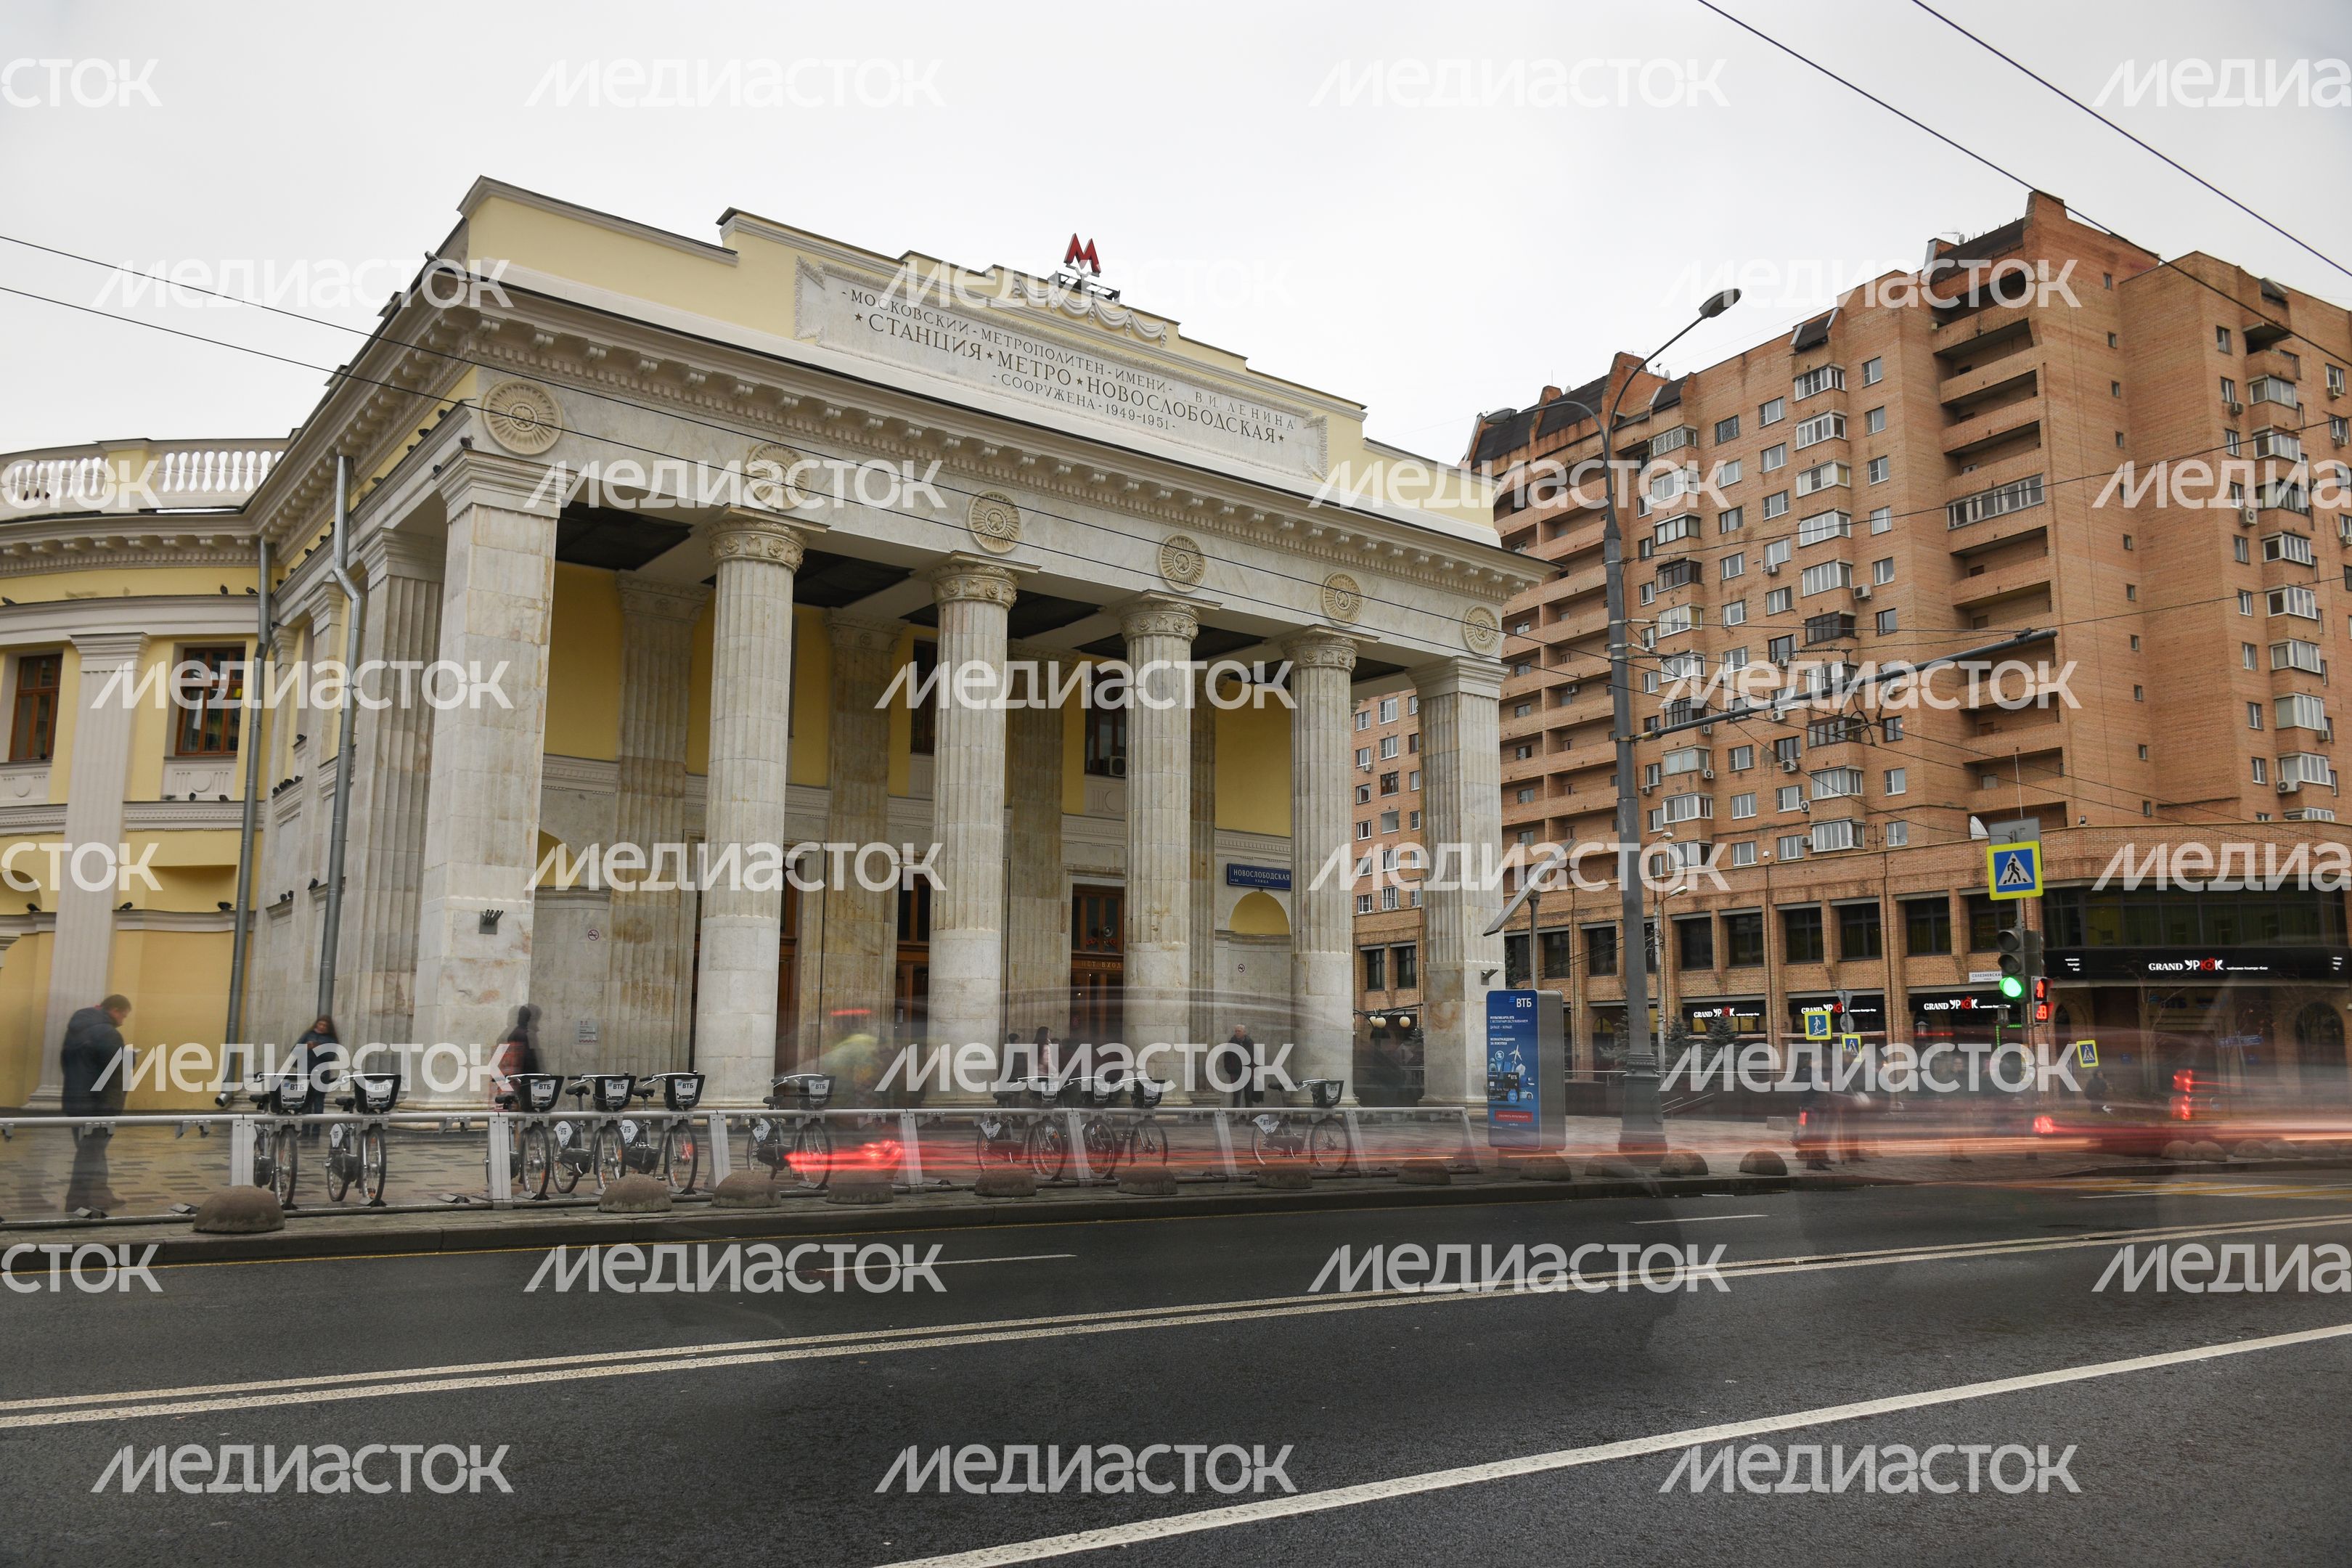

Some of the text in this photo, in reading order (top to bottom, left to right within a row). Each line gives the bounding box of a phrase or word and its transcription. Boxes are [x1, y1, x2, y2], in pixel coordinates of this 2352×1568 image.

[869, 314, 1275, 443] СТАНЦИЯ МЕТРО НОВОСЛОБОДСКАЯ
[981, 328, 1104, 375] МЕТРОПОЛИТЕН
[1115, 368, 1166, 393] ИМЕНИ
[1228, 401, 1294, 430] ЛЕНИНА
[1001, 374, 1095, 409] СООРУЖЕНА
[1233, 869, 1290, 881] НОВОСЛОБОДСКАЯ
[1516, 998, 1532, 1008] ВТБ
